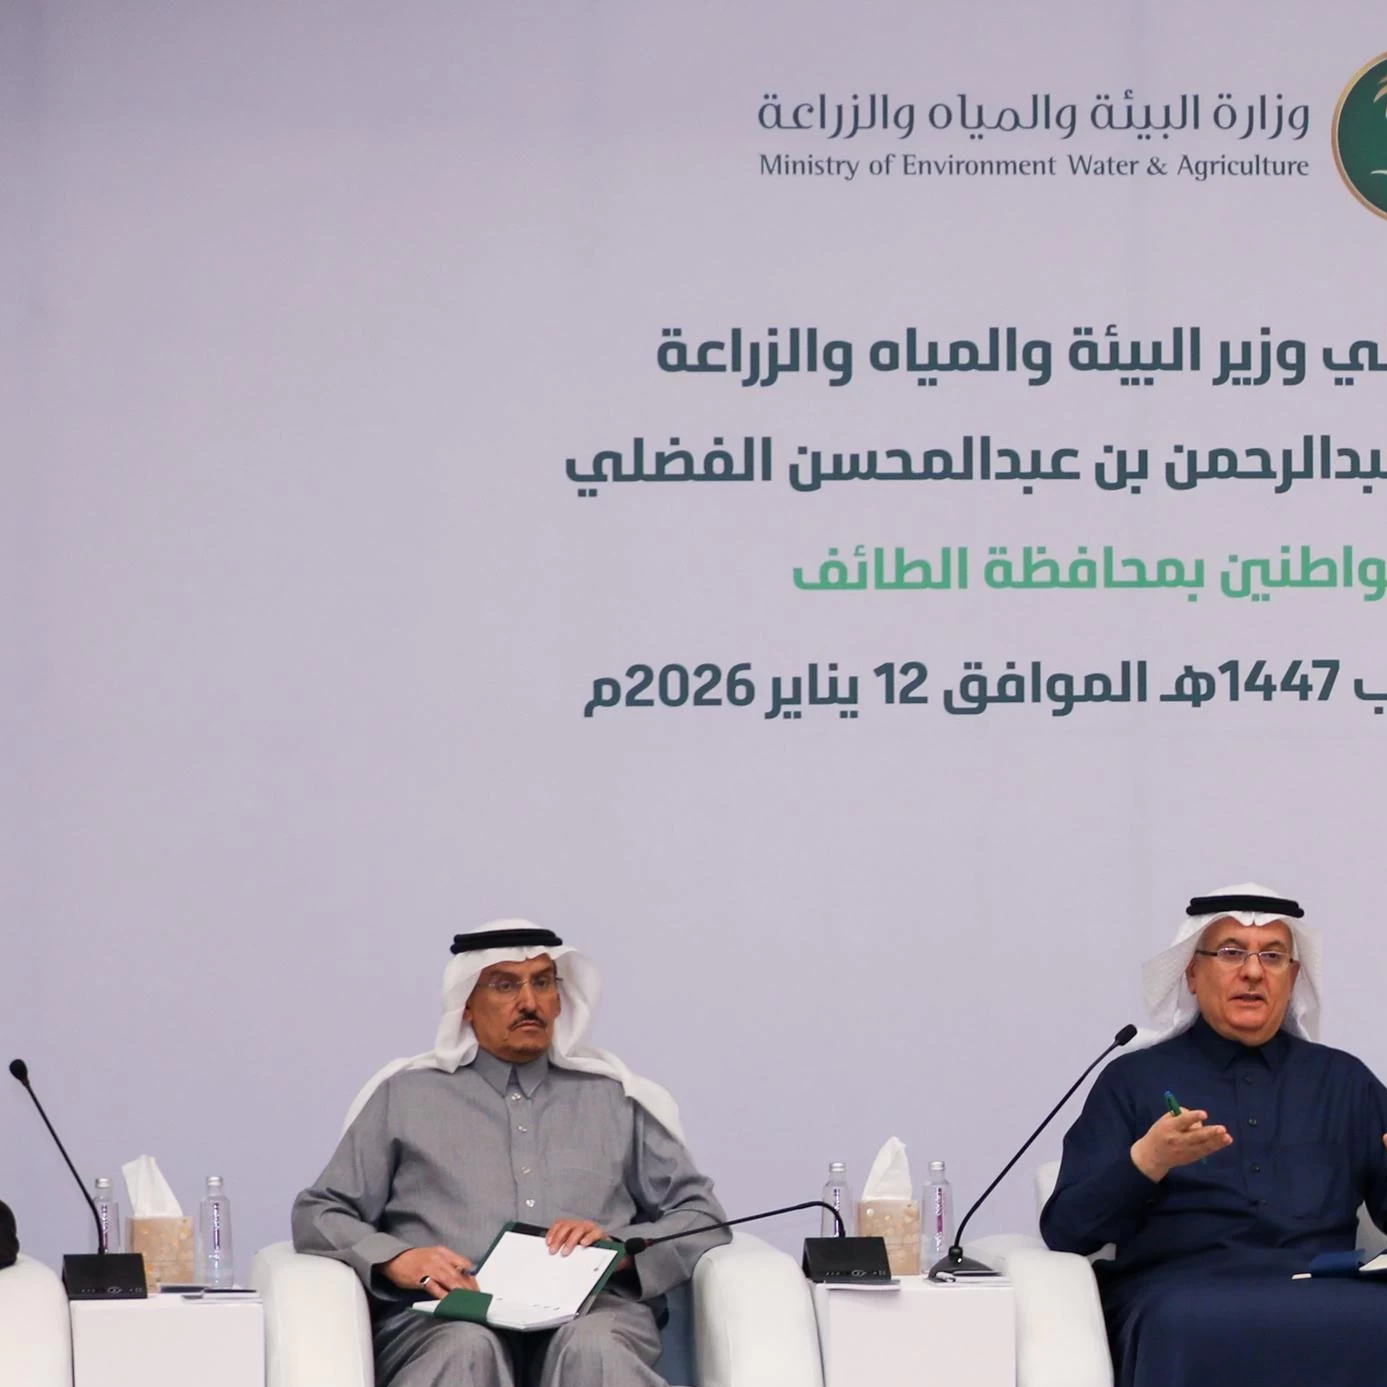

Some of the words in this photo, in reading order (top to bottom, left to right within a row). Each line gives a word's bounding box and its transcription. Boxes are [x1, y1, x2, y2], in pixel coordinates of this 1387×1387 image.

[757, 93, 915, 140] والزراعة
[928, 93, 1077, 141] والمياه
[1091, 88, 1200, 141] البيئة
[1213, 93, 1310, 141] وزارة
[759, 153, 860, 181] Ministry
[868, 153, 897, 176] of
[903, 153, 1057, 176] Environment
[1067, 154, 1140, 176] Water
[1146, 156, 1168, 176] &
[1177, 153, 1309, 182] Agriculture
[656, 327, 853, 387] والزراعة
[869, 327, 1053, 387] والمياه
[1069, 324, 1201, 387] البيئة
[1211, 327, 1307, 387] وزير
[566, 436, 773, 497] الفضلي
[788, 435, 1081, 495] عبدالمحسن
[1095, 445, 1149, 495] بن
[792, 545, 969, 591] الطائف
[984, 546, 1205, 603] بمحافظة
[764, 663, 859, 720] يناير
[872, 661, 929, 705] 12
[943, 659, 1148, 716] الموافق
